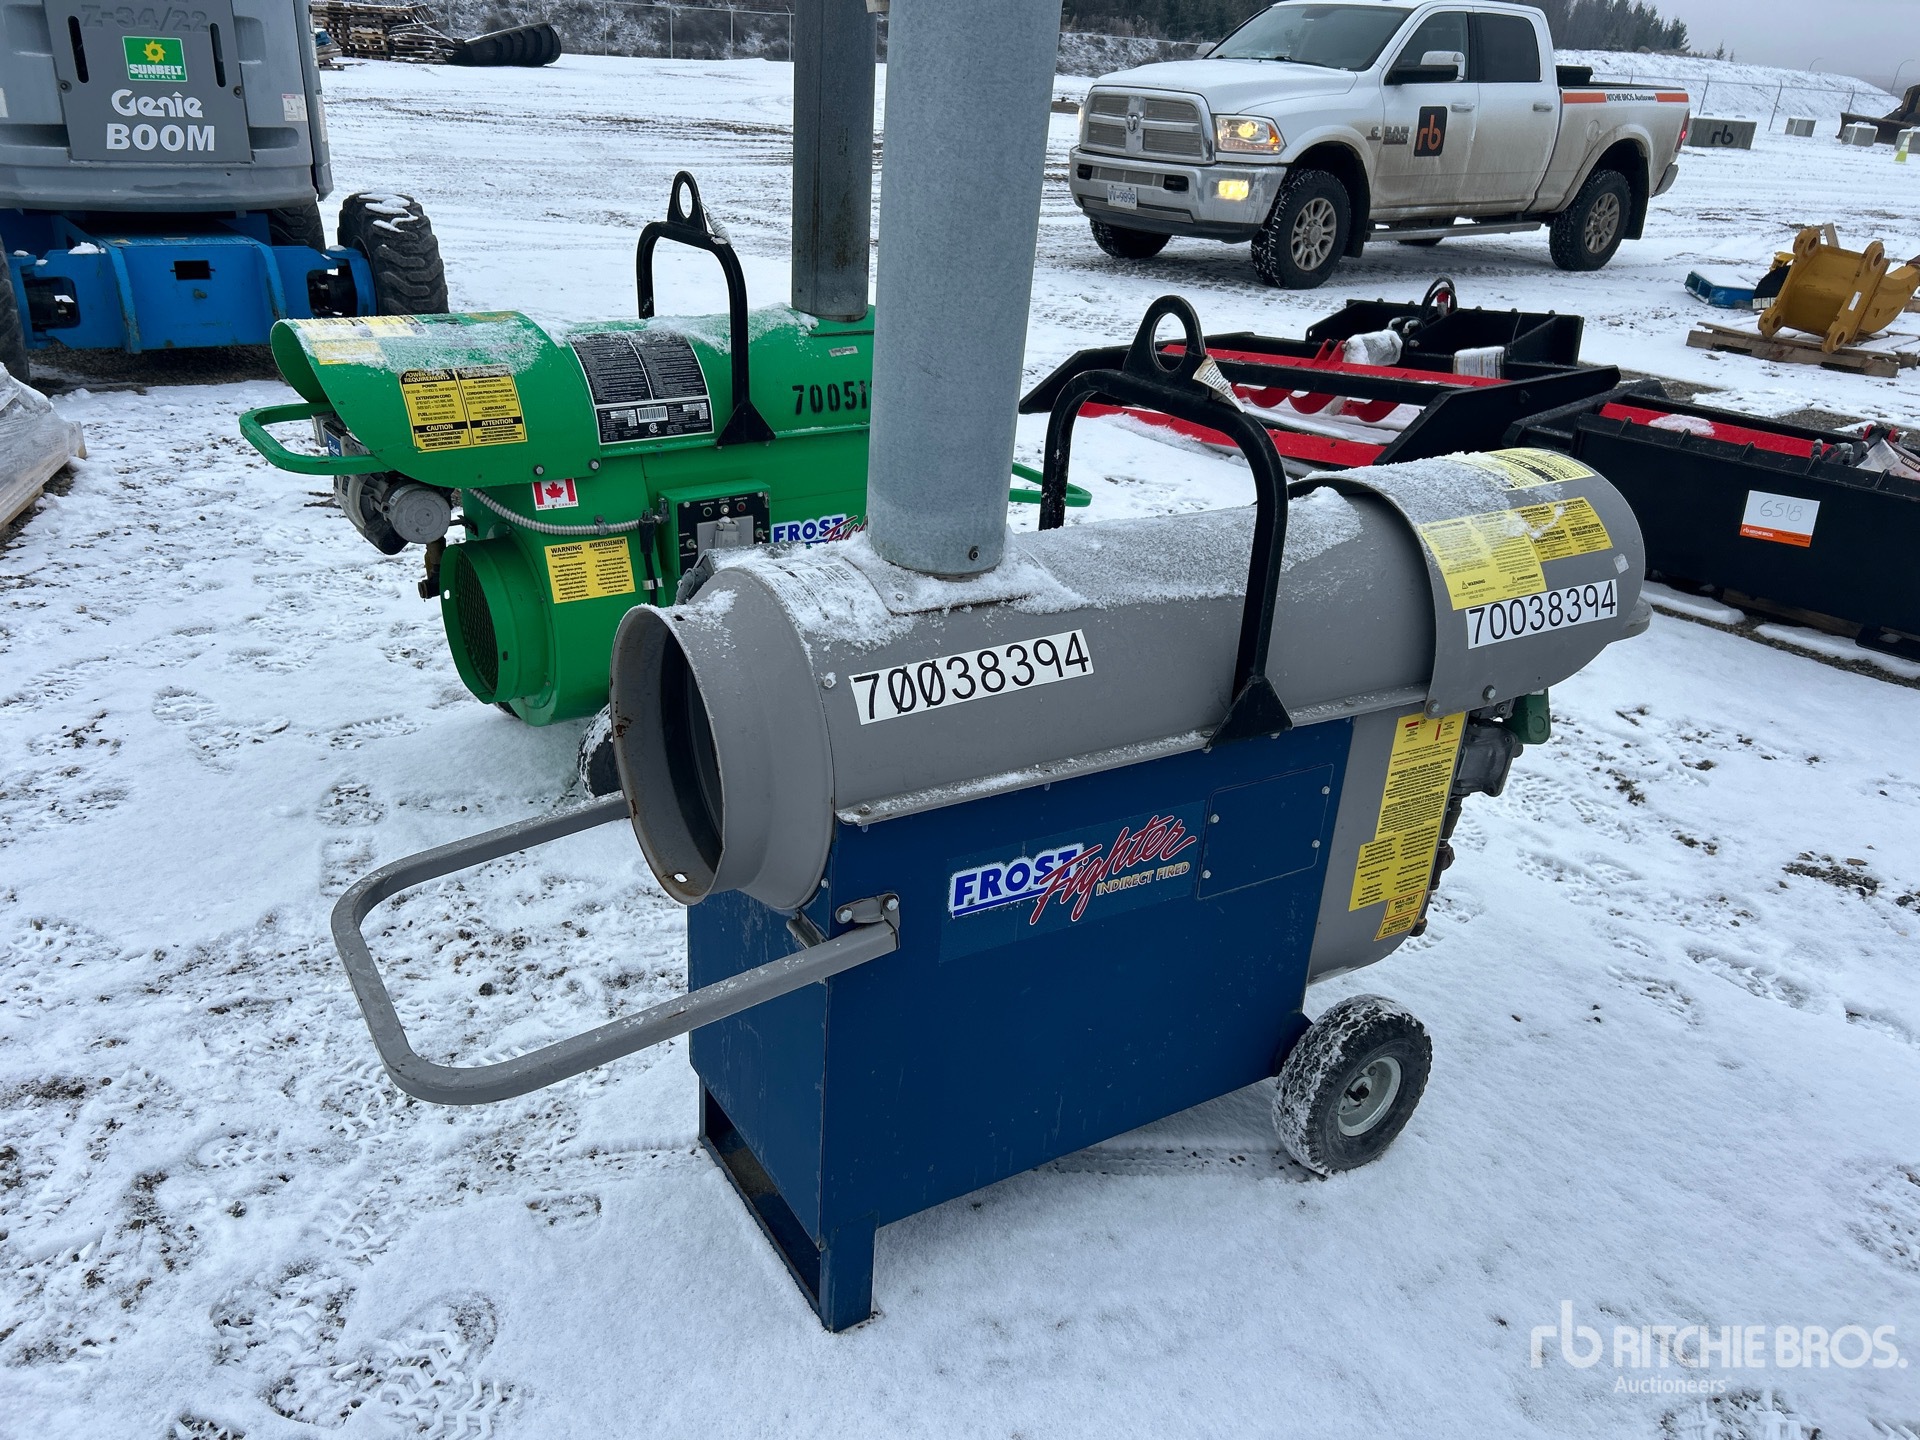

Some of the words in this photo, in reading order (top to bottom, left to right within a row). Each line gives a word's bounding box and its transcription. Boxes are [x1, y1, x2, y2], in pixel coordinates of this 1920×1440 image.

[129, 64, 183, 75] SUNBELT
[111, 89, 203, 118] Genie
[106, 123, 215, 152] BOOM
[1416, 114, 1441, 150] rb
[1711, 124, 1734, 145] rb
[792, 380, 872, 415] 70051
[481, 418, 513, 426] ATTENTION
[1760, 500, 1803, 521] 6518
[773, 516, 847, 543] FROST
[551, 545, 582, 553] WARNING
[1469, 581, 1615, 644] 70038394
[853, 632, 1089, 720] 70038394
[952, 848, 1079, 908] FROST
[1029, 815, 1197, 926] Fighter
[1096, 870, 1153, 896] INDIRECT
[1156, 861, 1190, 881] FIRED
